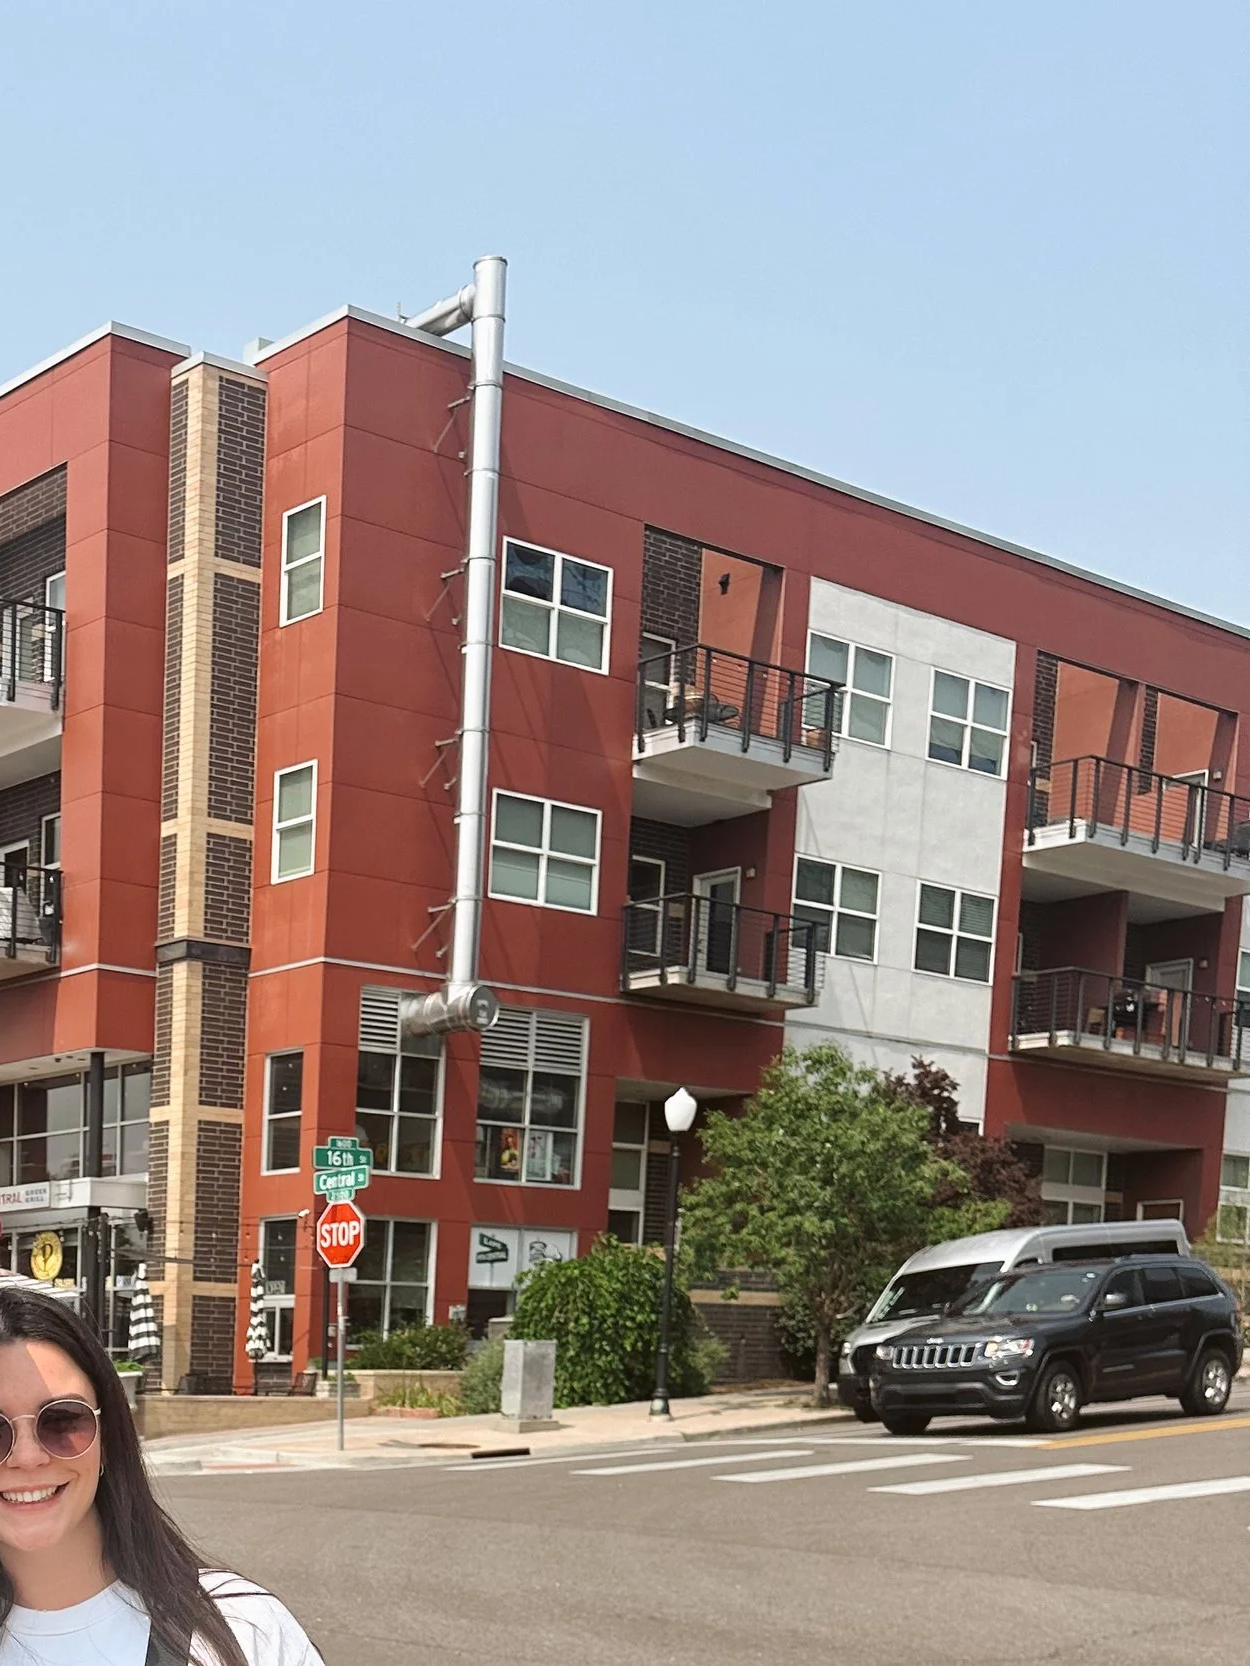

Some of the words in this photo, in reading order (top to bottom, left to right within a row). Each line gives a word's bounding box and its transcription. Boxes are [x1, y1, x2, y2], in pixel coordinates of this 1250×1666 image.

[327, 1150, 354, 1166] 16th
[319, 1171, 356, 1190] Central
[320, 1221, 360, 1249] STOP
